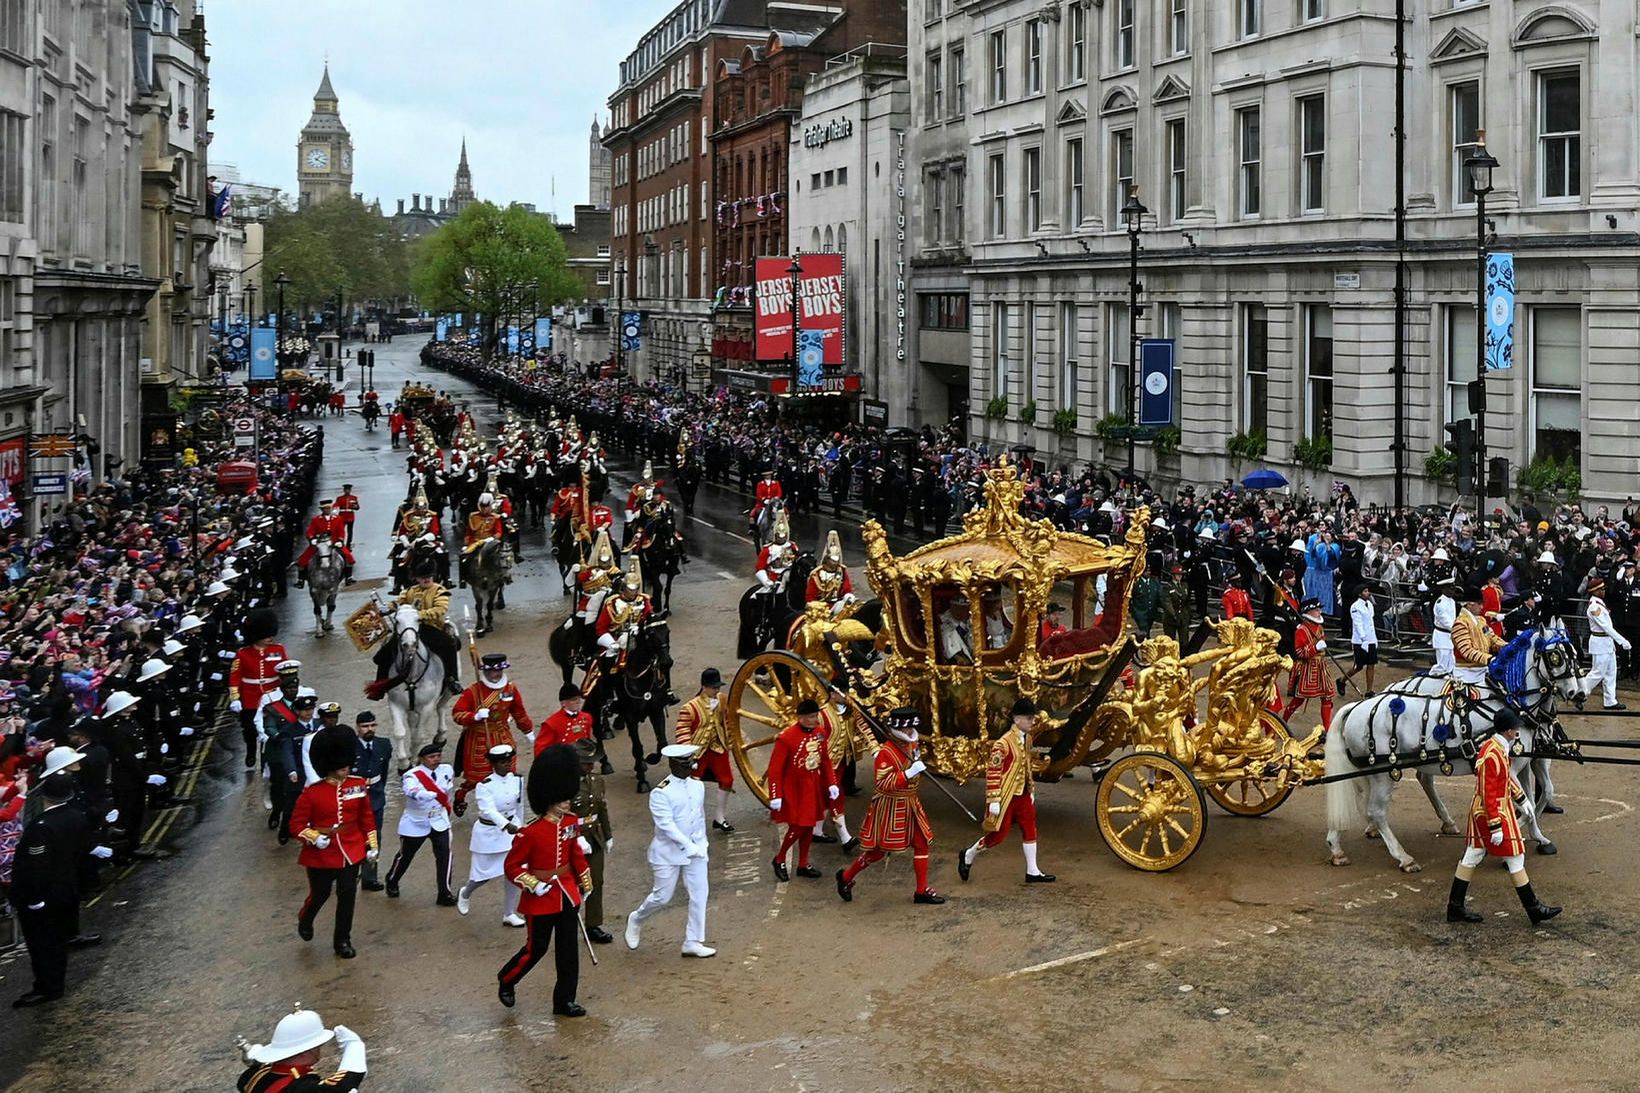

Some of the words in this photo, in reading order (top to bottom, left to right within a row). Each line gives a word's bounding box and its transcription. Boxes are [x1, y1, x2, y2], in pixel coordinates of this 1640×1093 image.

[804, 124, 829, 149] Trafalgar
[828, 116, 852, 141] Theatre
[897, 132, 905, 252] Trafalgar
[800, 275, 842, 297] JERSEY
[803, 293, 842, 318] BOYS
[897, 262, 905, 360] Theatre
[822, 378, 845, 392] BOYS
